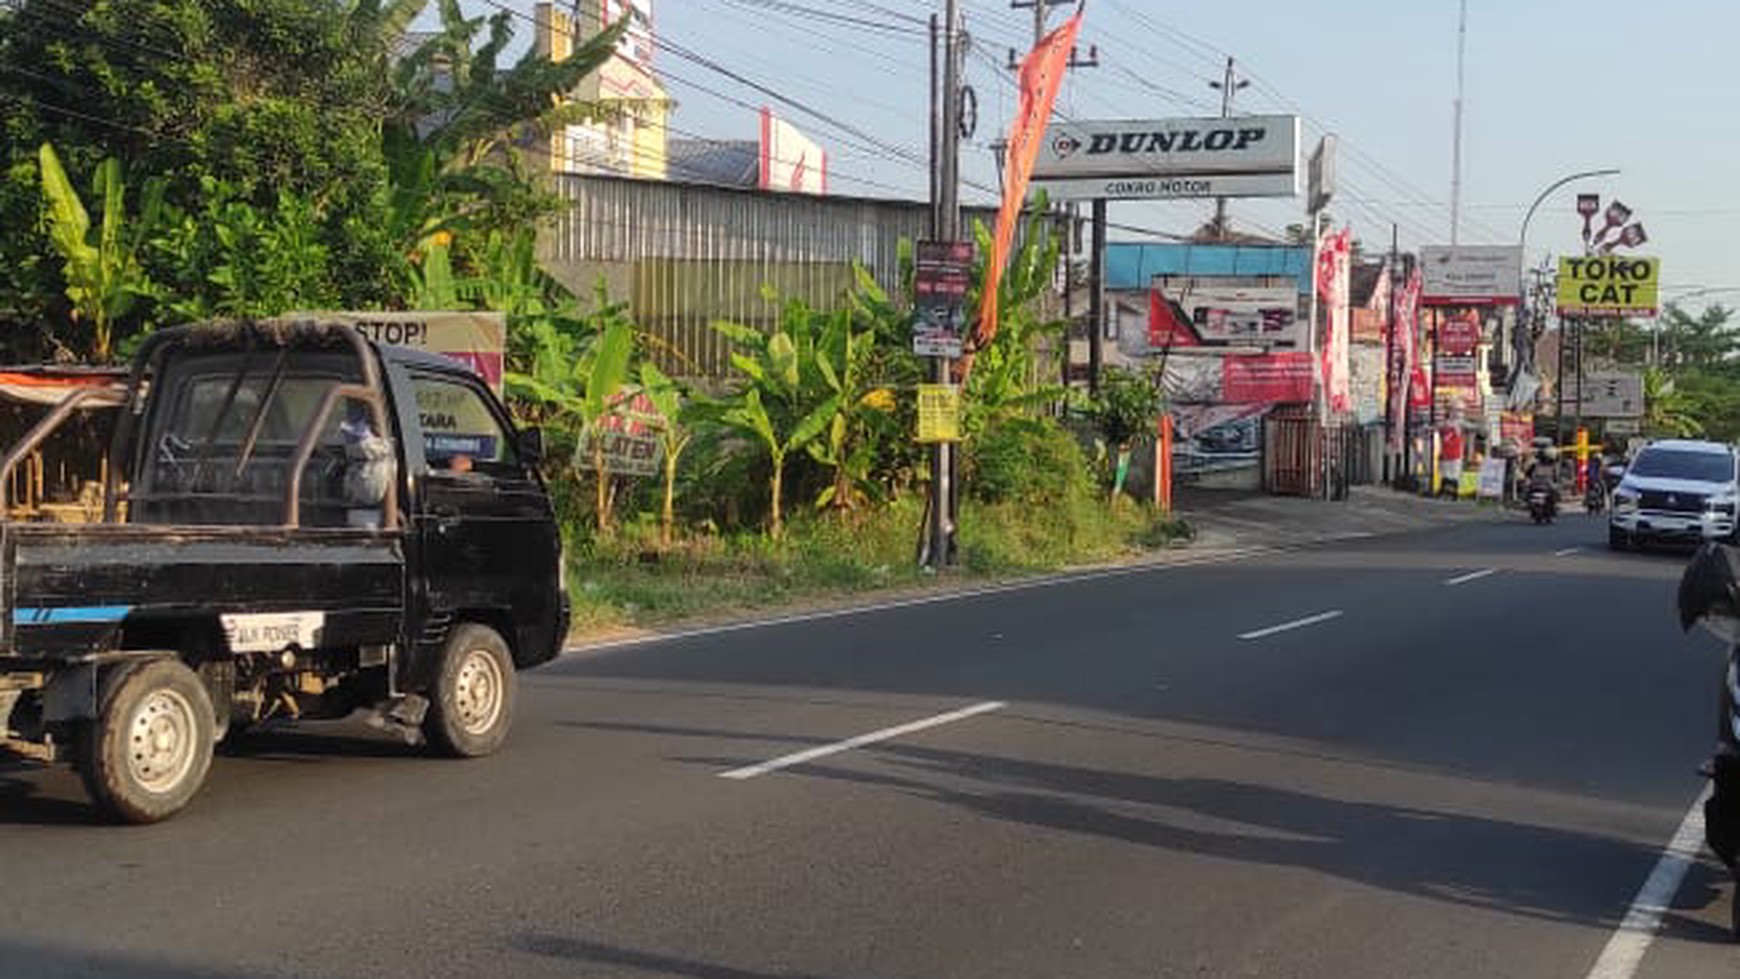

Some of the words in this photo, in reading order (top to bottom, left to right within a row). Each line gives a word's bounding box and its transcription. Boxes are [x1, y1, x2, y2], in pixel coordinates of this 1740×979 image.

[1086, 127, 1266, 155] DUNLOP
[1160, 180, 1210, 194] MOTOR
[1567, 258, 1651, 281] TOKO
[1580, 283, 1639, 304] CAT
[355, 320, 427, 345] STOP!
